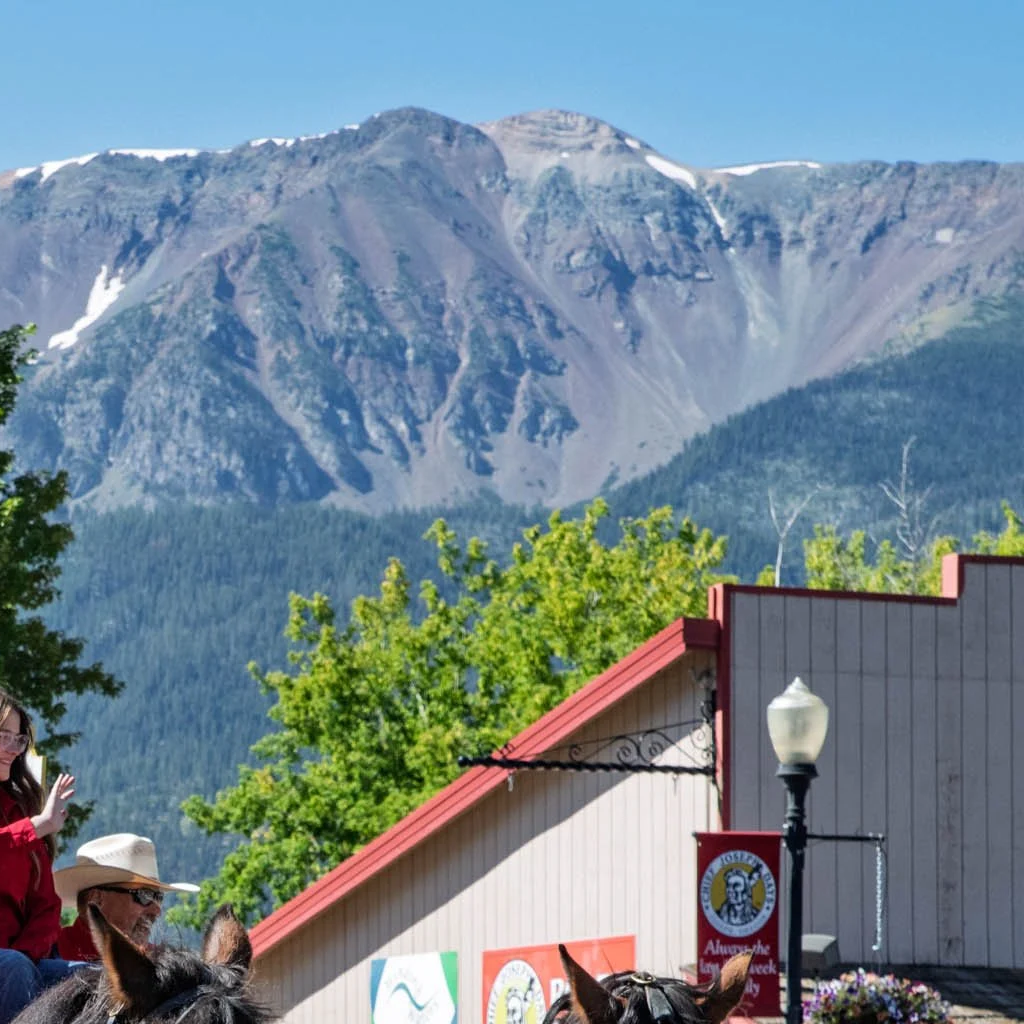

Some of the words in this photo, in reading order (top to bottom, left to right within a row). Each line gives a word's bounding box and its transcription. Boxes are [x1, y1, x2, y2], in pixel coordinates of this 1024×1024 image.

[703, 866, 714, 902] CHIEF
[720, 851, 758, 866] JOSEPH
[763, 872, 774, 903] DAYS
